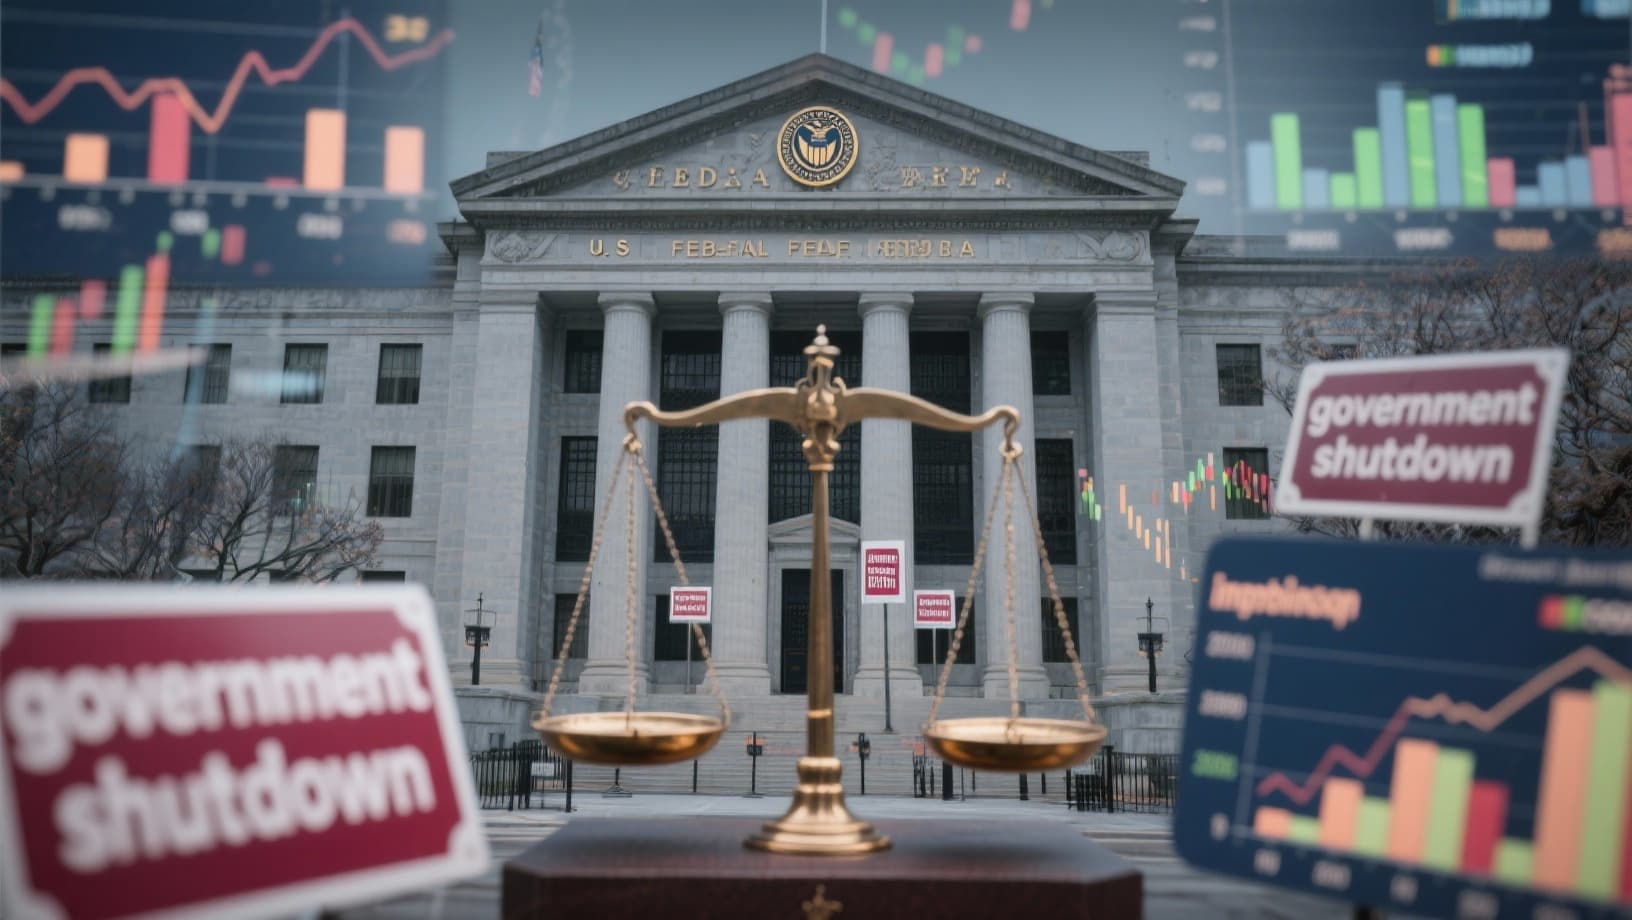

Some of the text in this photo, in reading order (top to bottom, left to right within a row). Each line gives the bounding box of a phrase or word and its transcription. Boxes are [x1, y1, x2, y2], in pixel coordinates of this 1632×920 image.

[1307, 380, 1537, 438] government
[1310, 433, 1514, 484] shutdown
[2, 637, 433, 774] government
[53, 736, 438, 873] shutdown
